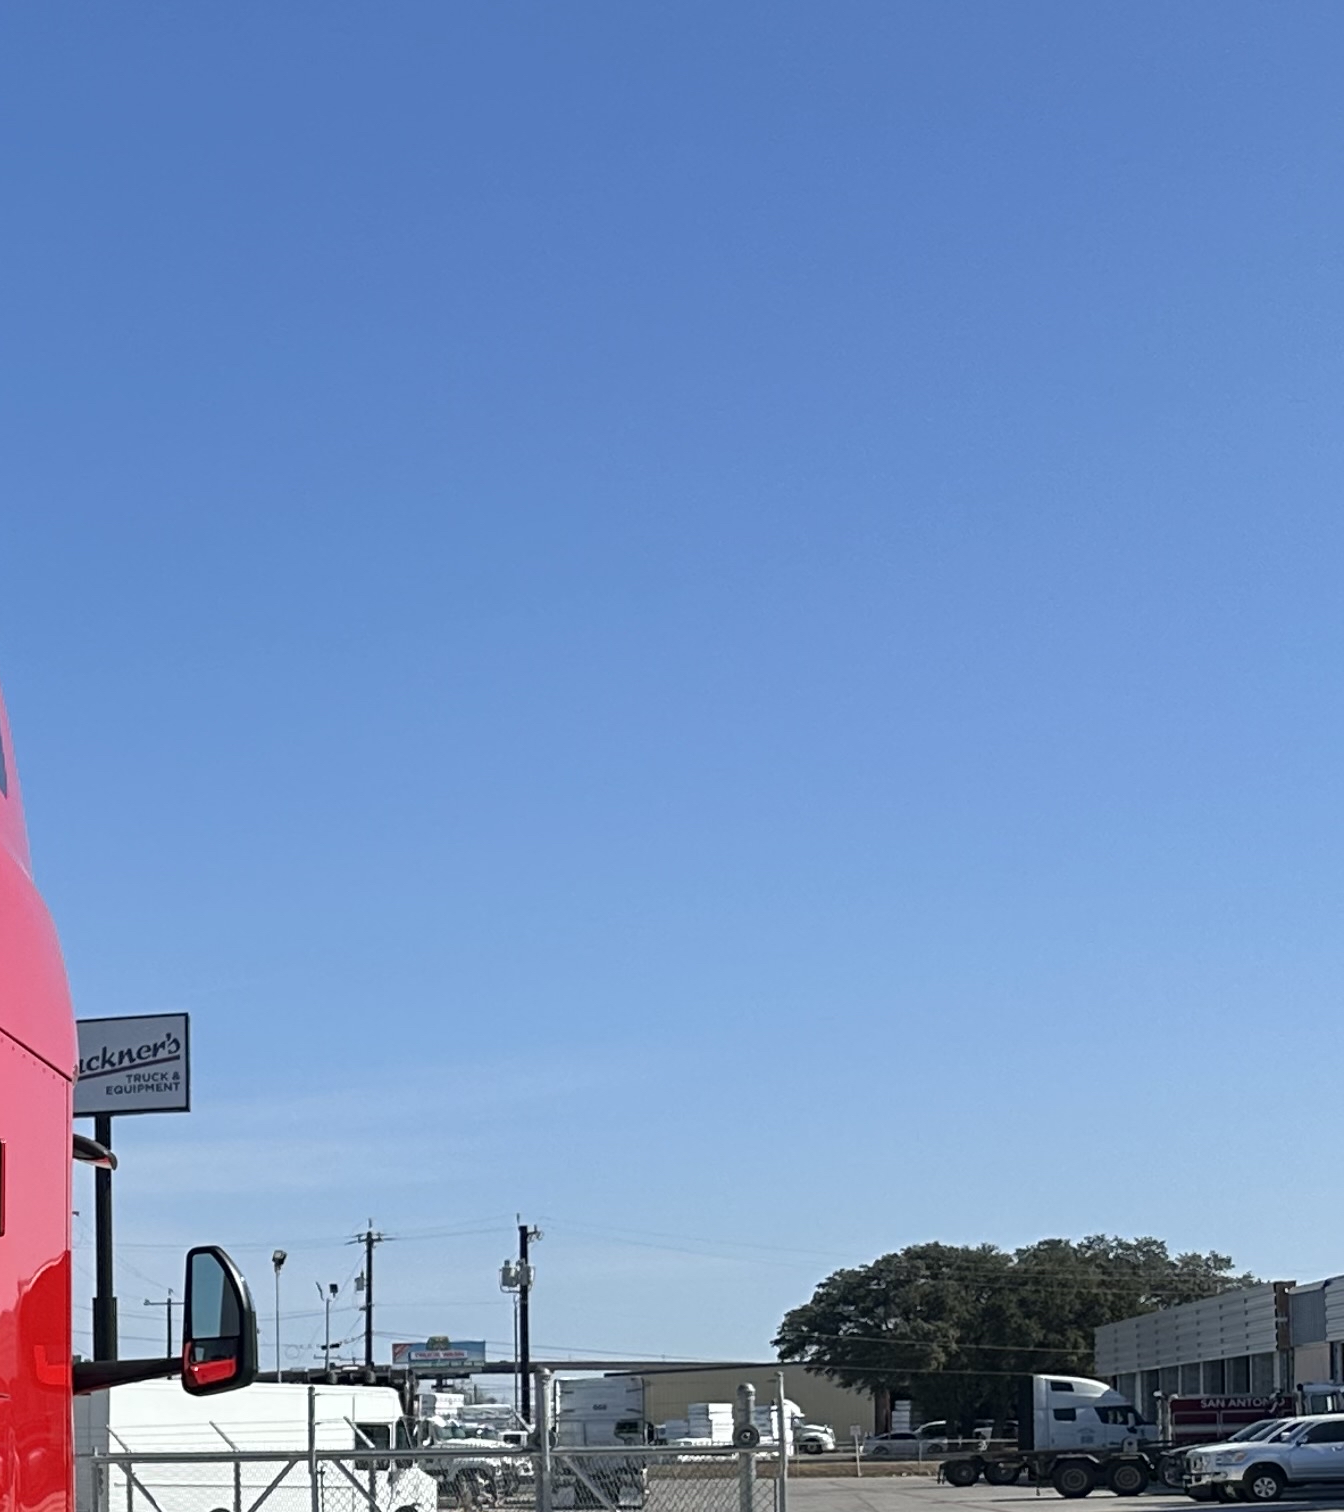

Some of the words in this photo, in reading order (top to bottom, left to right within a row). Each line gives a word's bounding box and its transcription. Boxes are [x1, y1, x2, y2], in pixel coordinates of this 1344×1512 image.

[126, 1072, 169, 1084] TRUCK
[172, 1071, 181, 1081] &
[106, 1082, 181, 1095] EQUIPMENT
[1200, 1399, 1226, 1409] SAN
